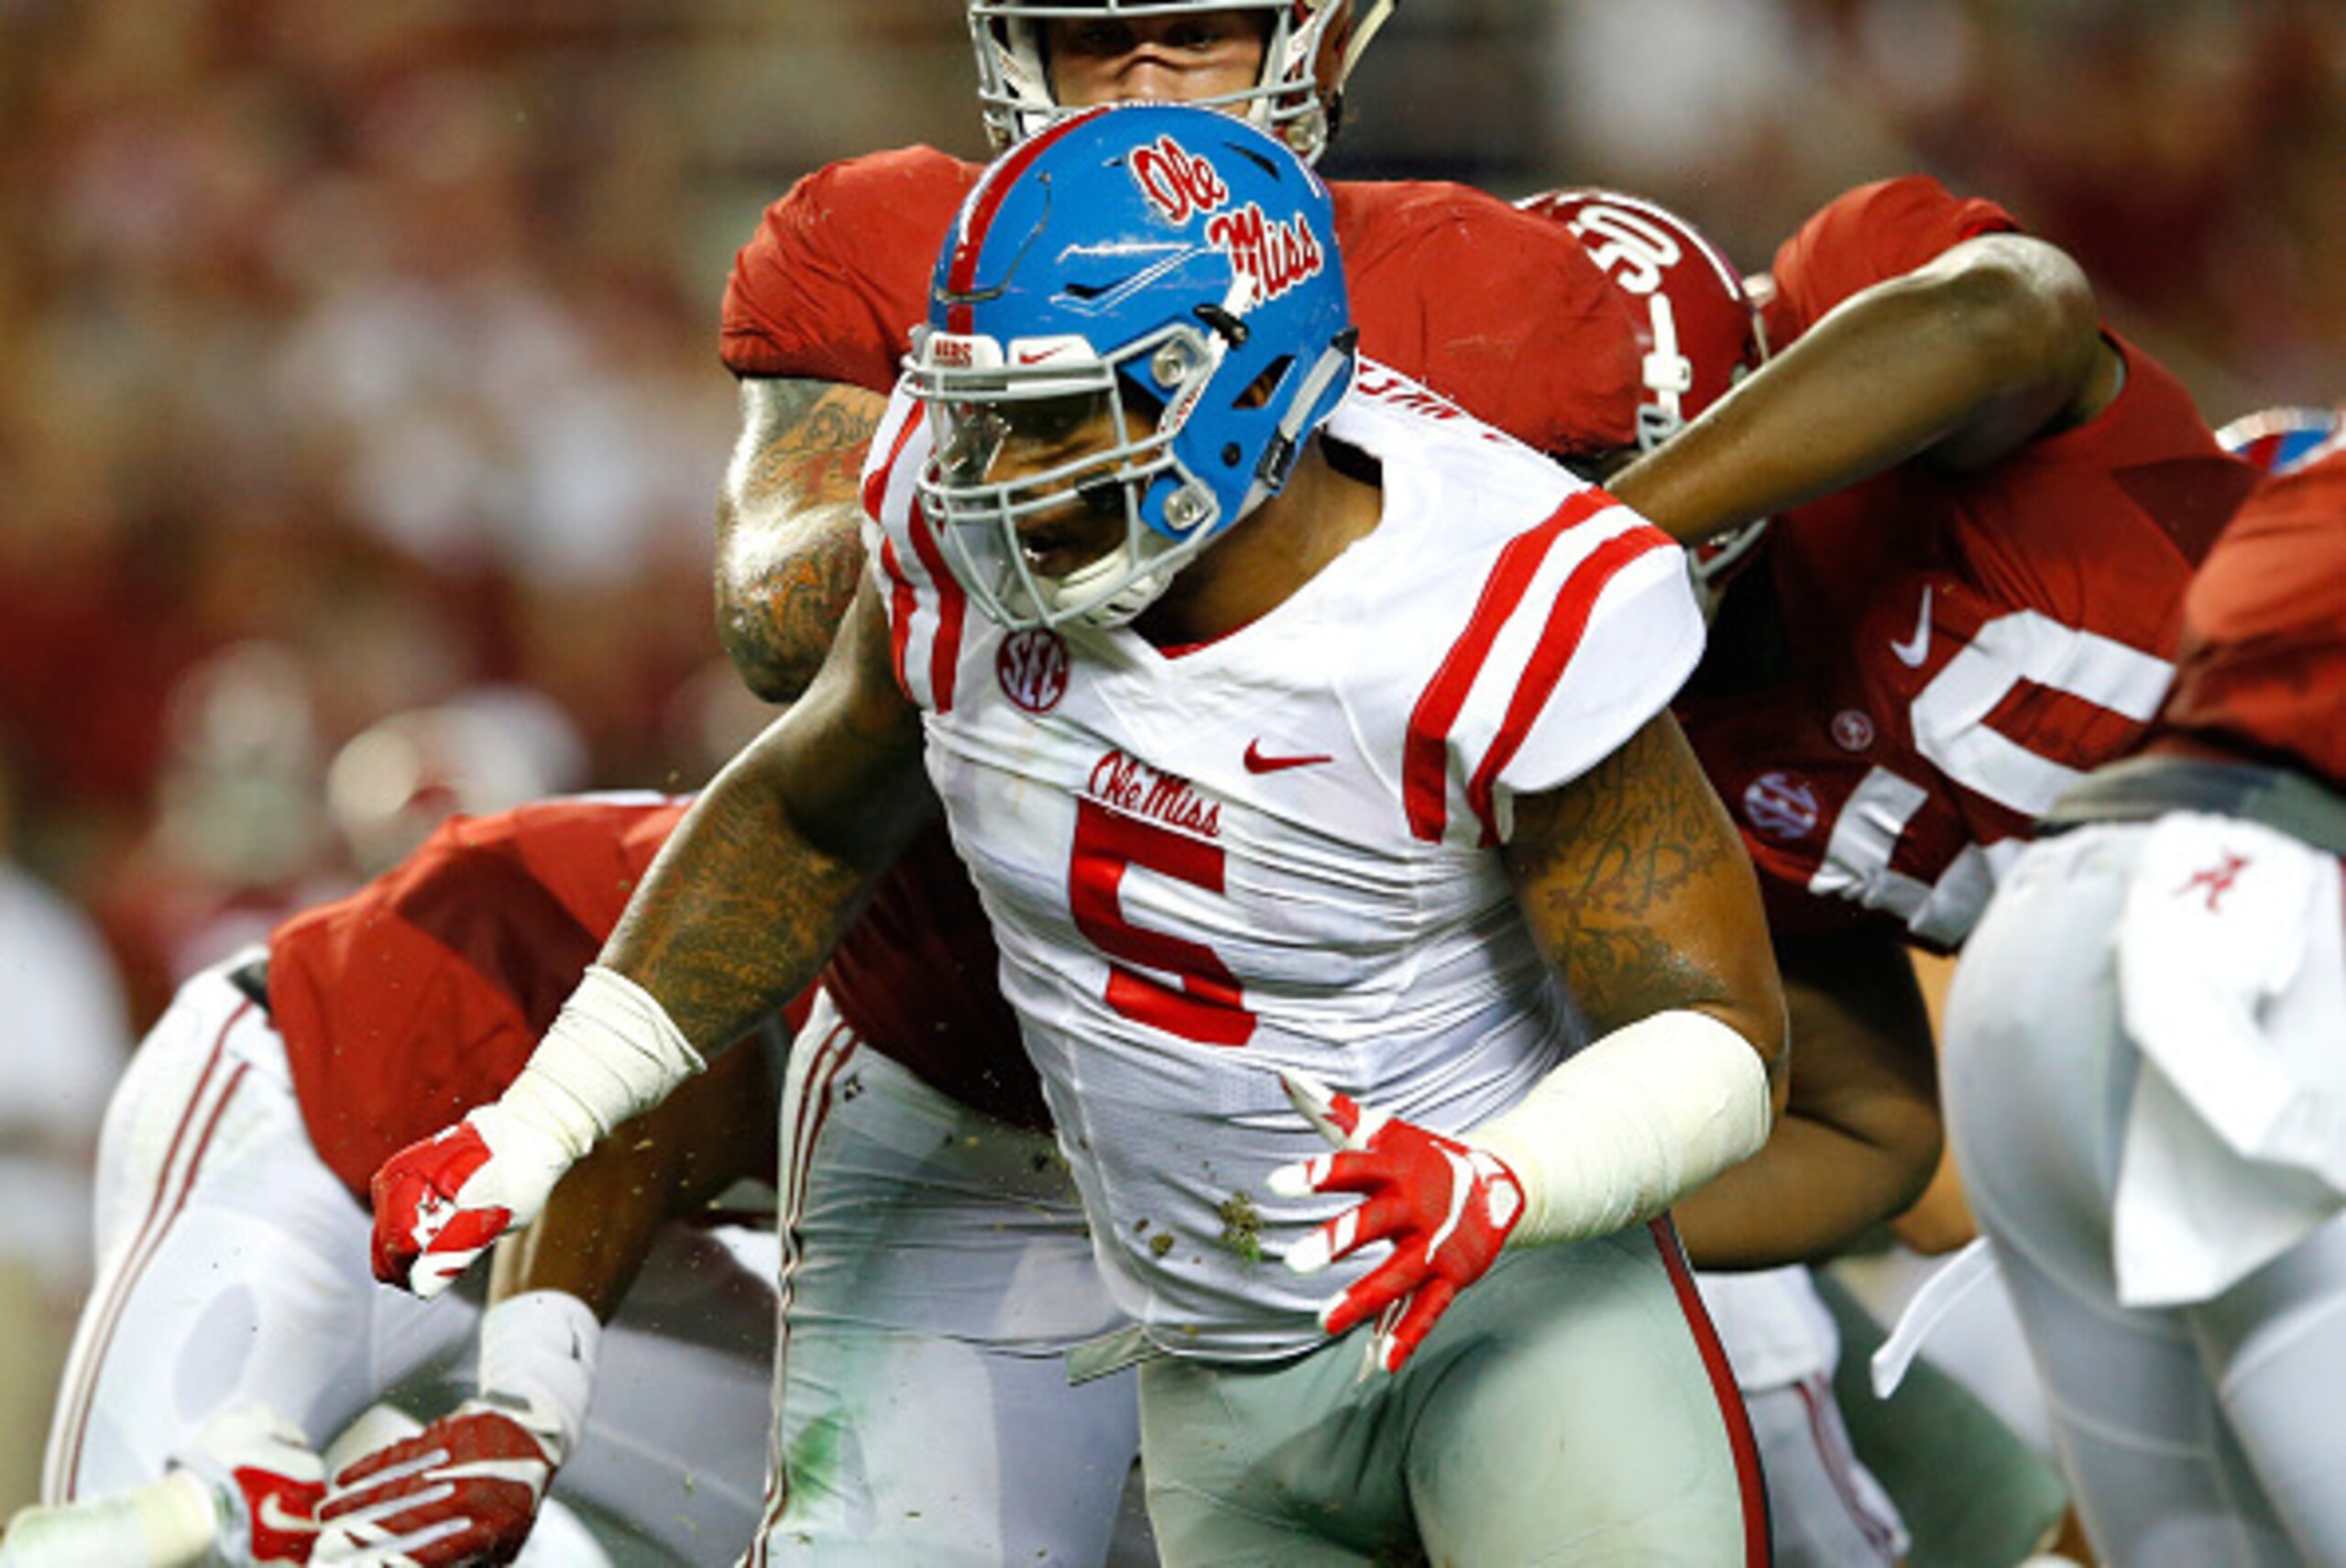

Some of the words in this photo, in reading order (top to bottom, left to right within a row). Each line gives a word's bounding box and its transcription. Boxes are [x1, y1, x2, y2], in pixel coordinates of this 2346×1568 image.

[1129, 135, 1228, 226] Ole
[1207, 203, 1322, 307] Miss
[1002, 631, 1065, 709] SEC
[1089, 749, 1142, 807] Ole
[1140, 766, 1222, 838] Miss
[1069, 795, 1257, 1047] 5
